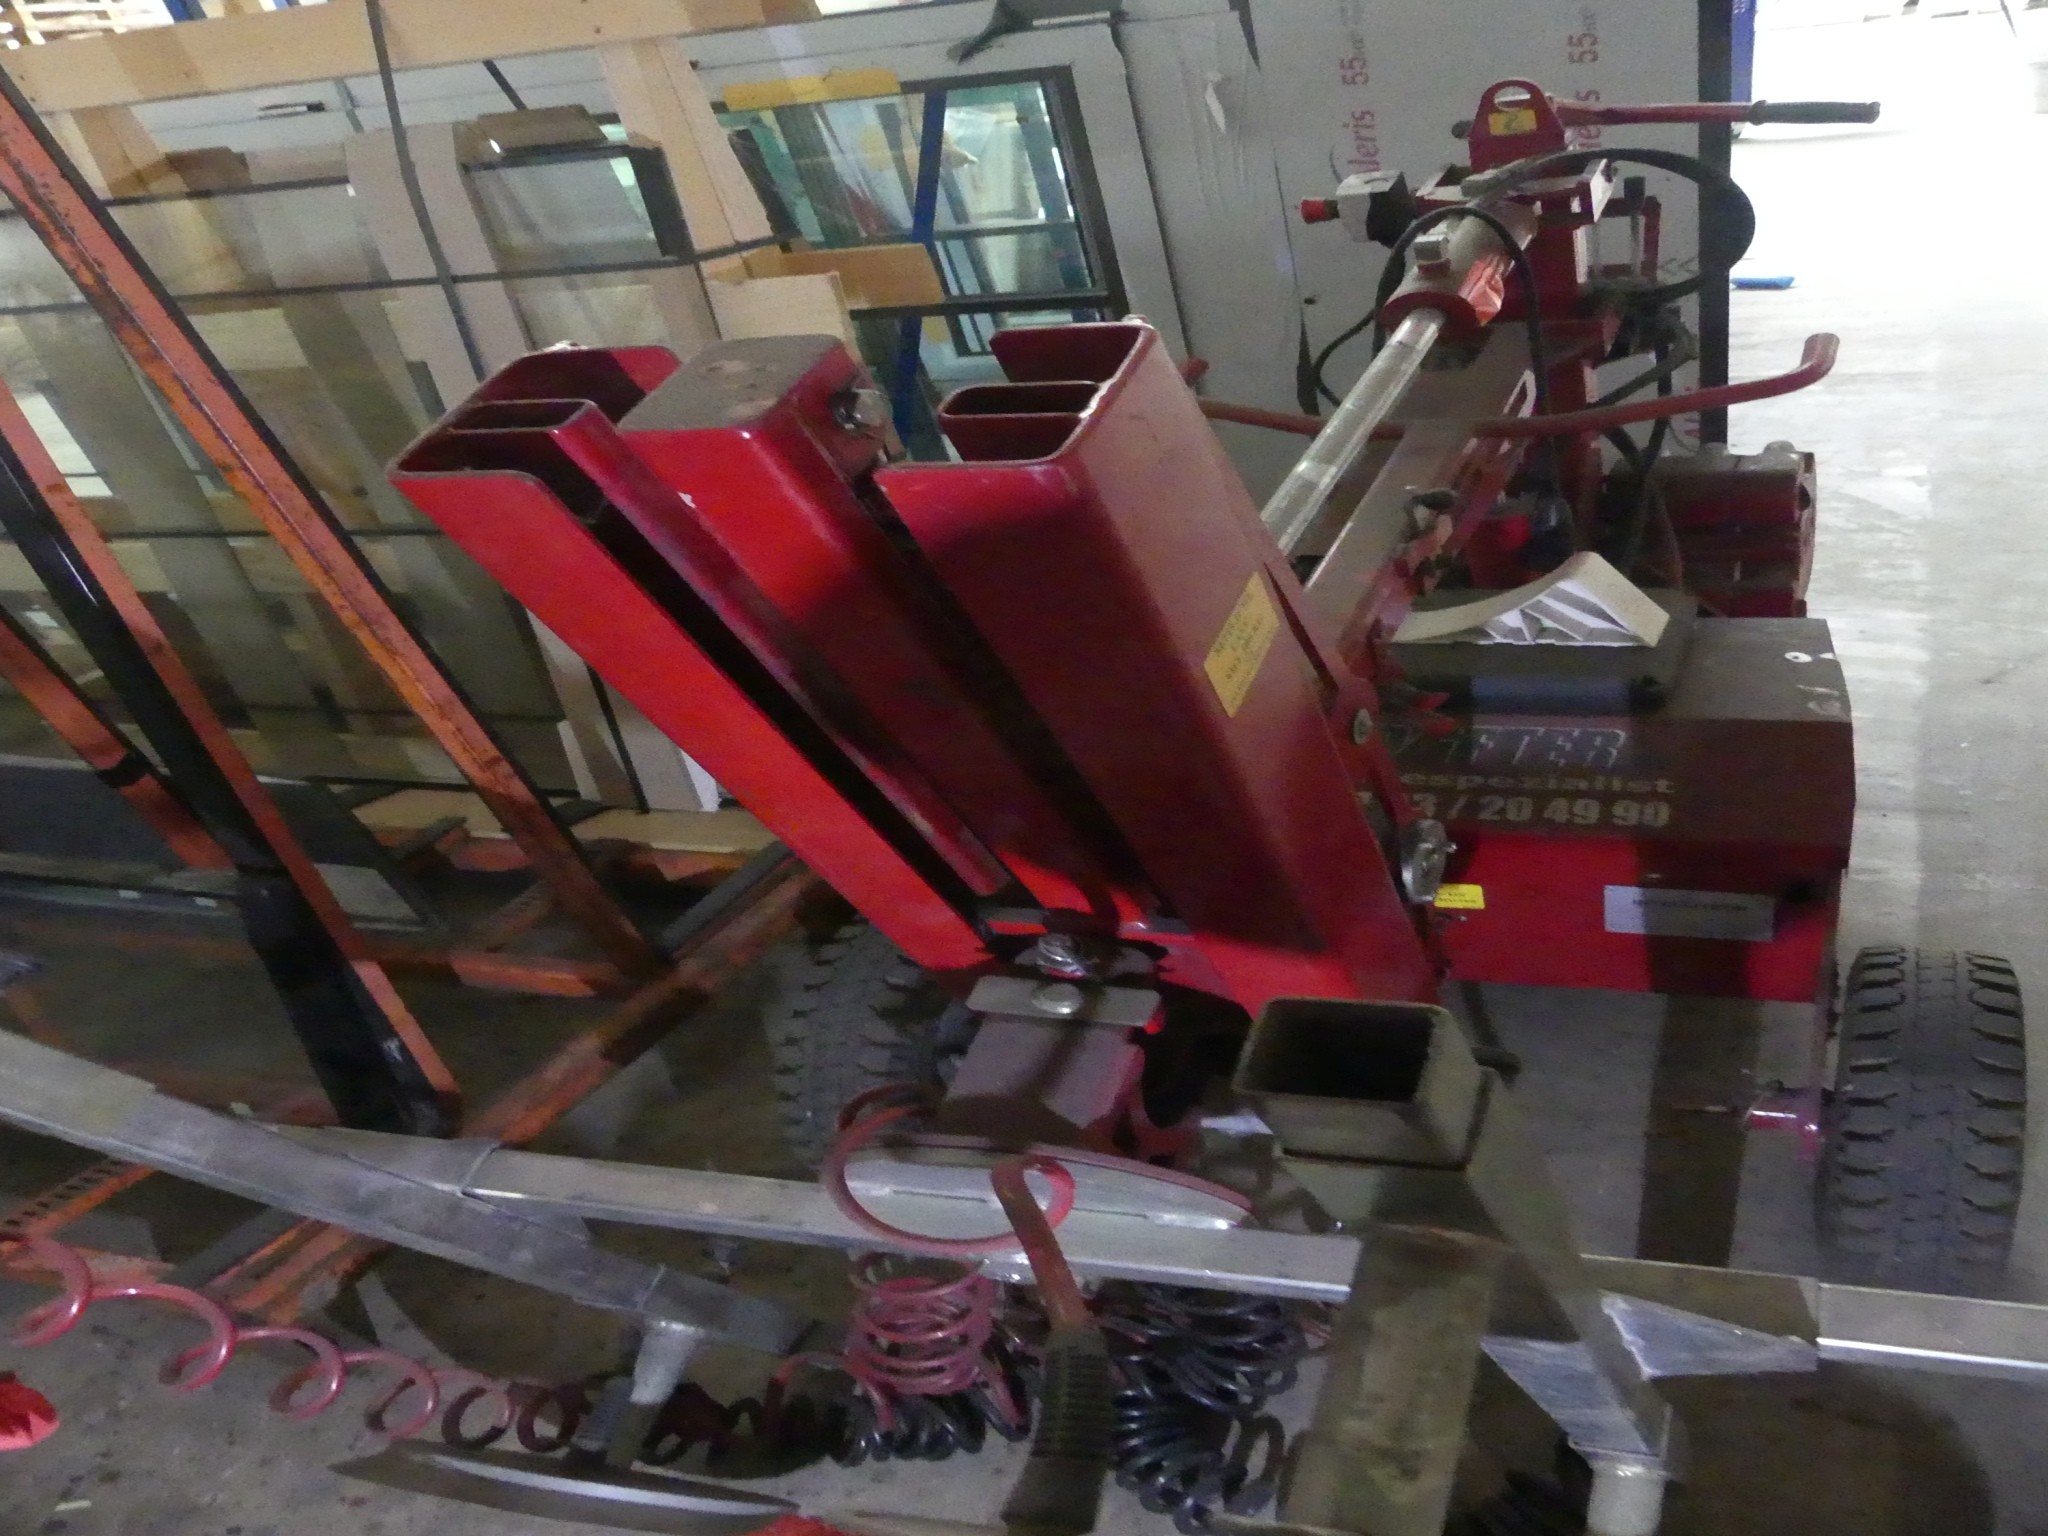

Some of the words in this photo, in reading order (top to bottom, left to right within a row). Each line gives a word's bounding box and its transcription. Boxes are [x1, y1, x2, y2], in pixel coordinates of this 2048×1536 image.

[1567, 32, 1599, 64] 55
[1342, 110, 1381, 174] leris
[1400, 773, 1676, 794] espezialist
[1477, 795, 1535, 822] 20
[1544, 797, 1601, 825] 49
[1611, 799, 1672, 827] 90
